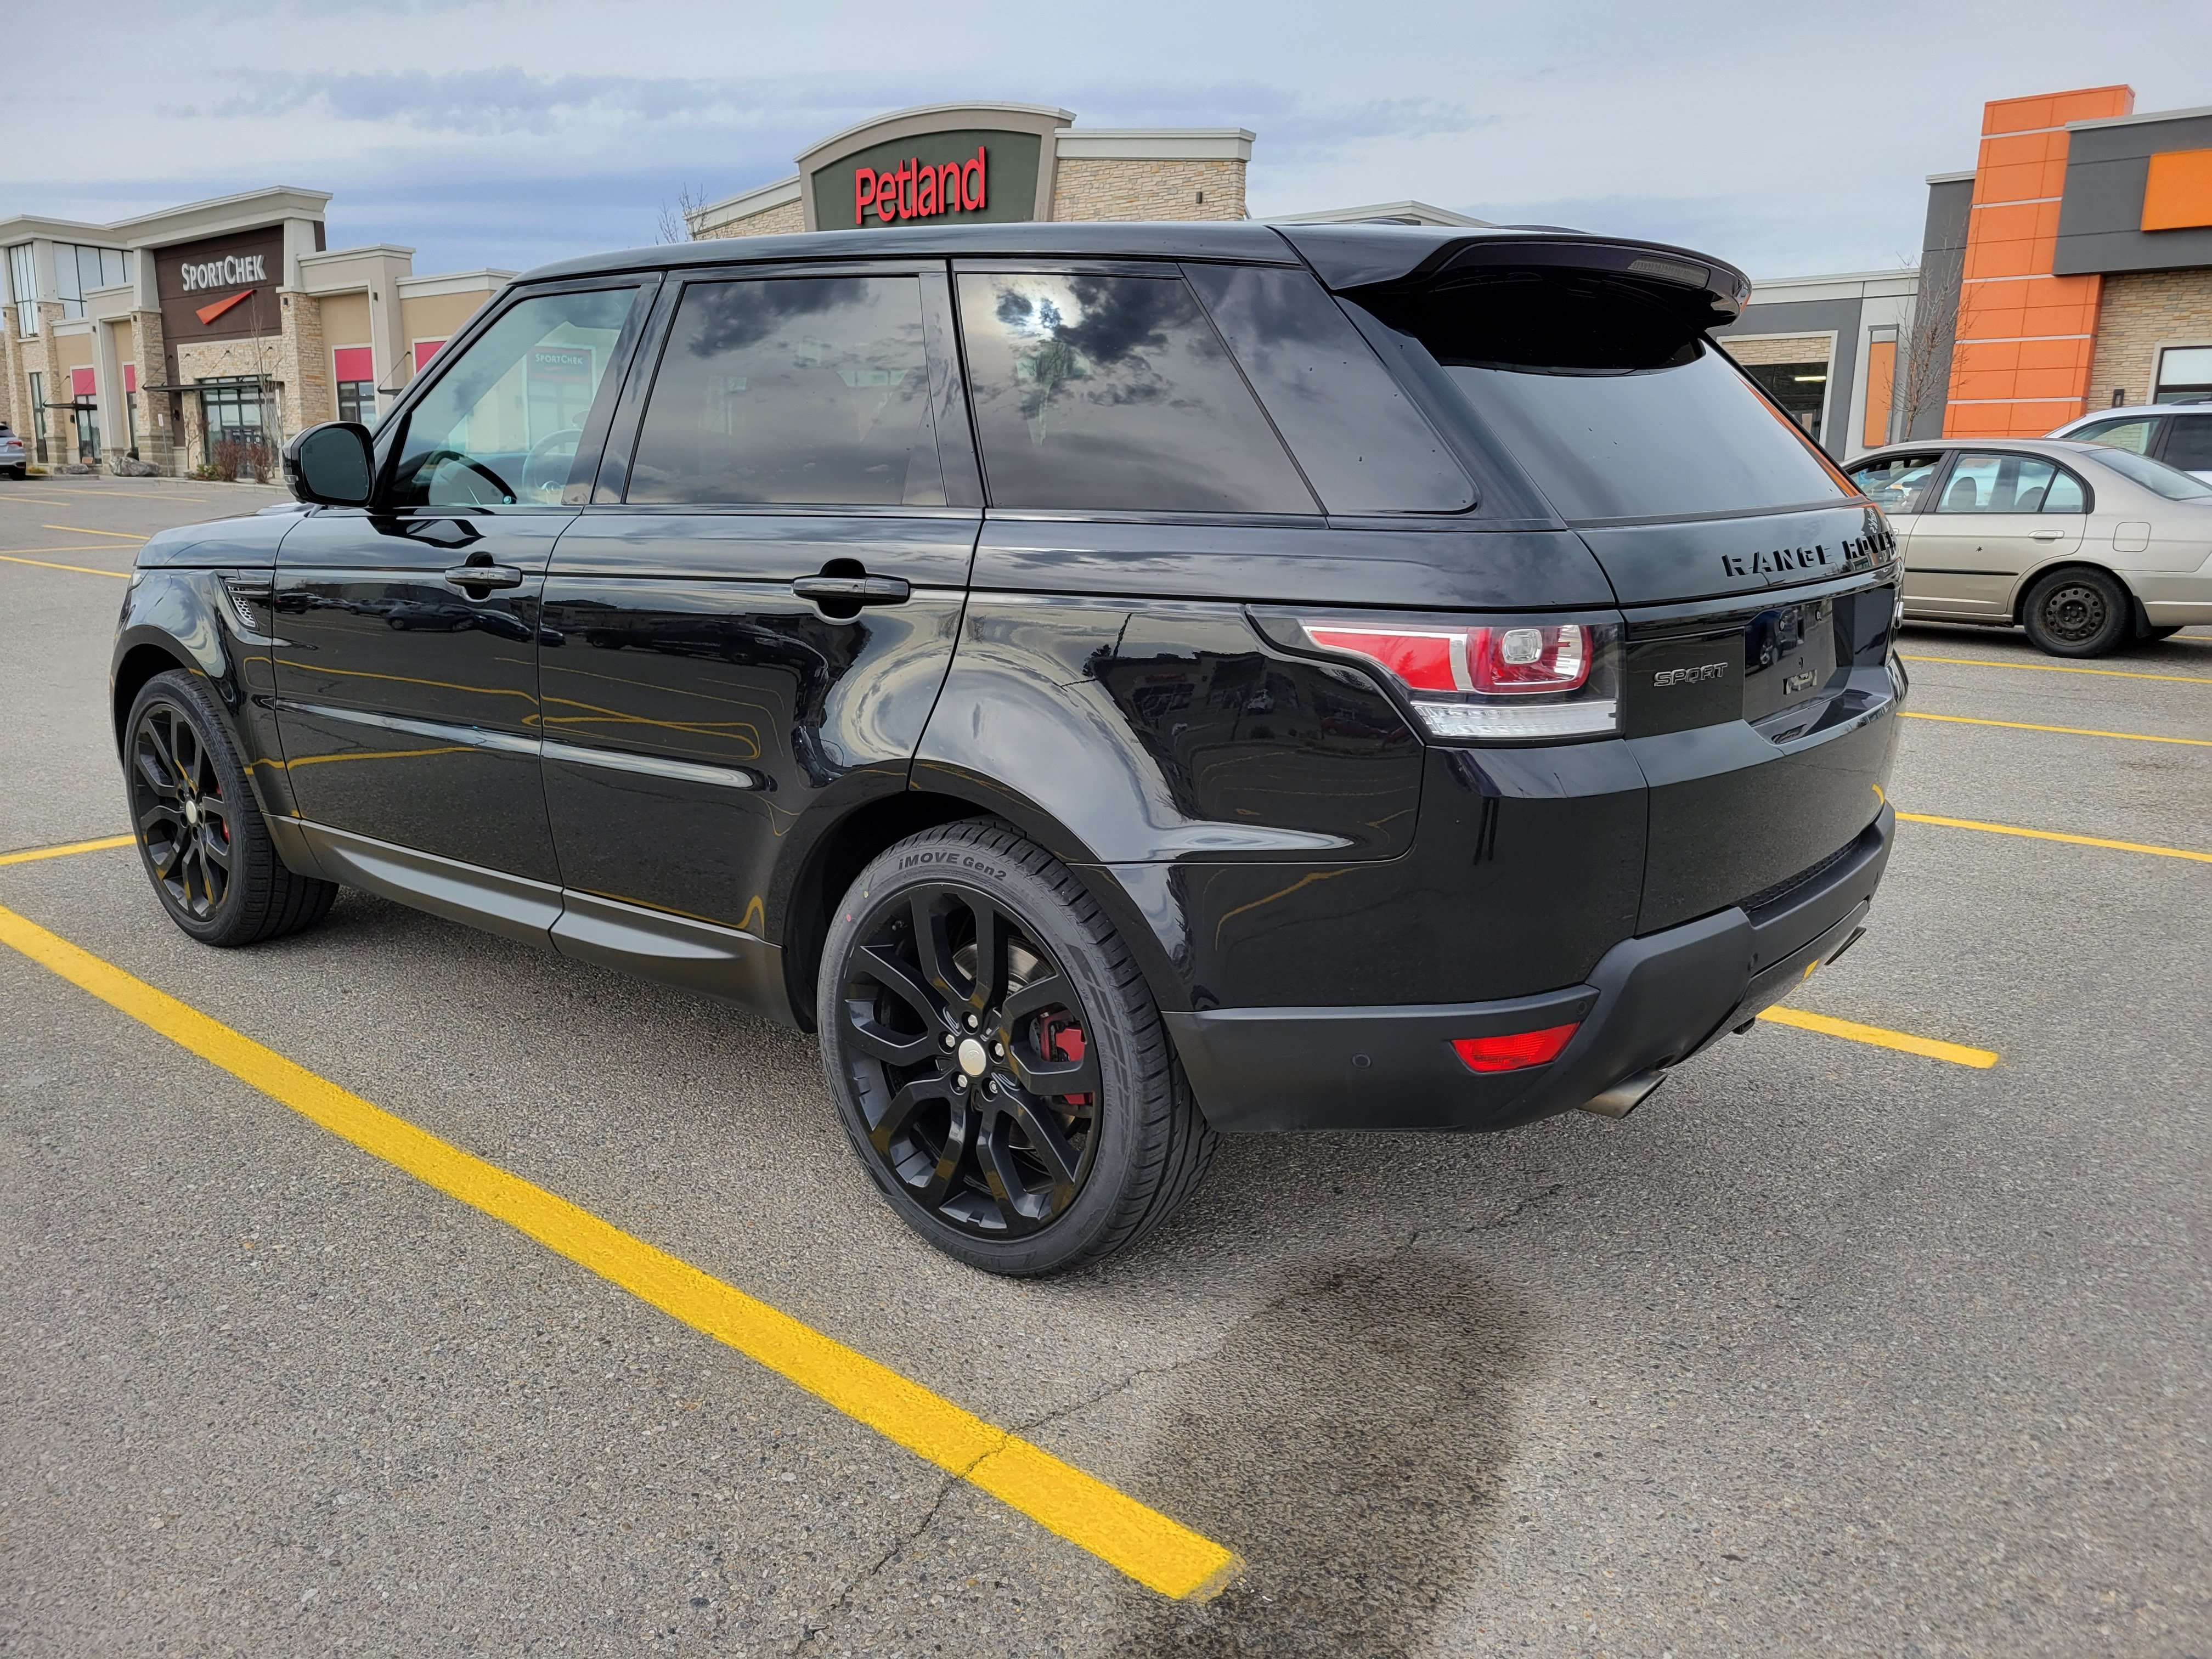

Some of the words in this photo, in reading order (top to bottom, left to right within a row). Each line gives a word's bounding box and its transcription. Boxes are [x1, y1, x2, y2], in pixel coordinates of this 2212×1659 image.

[855, 145, 986, 224] Petland
[1721, 544, 1836, 577] RANGE
[1653, 662, 1728, 687] SPORT
[899, 851, 960, 870] iMOVE
[963, 856, 1007, 881] Gen2
